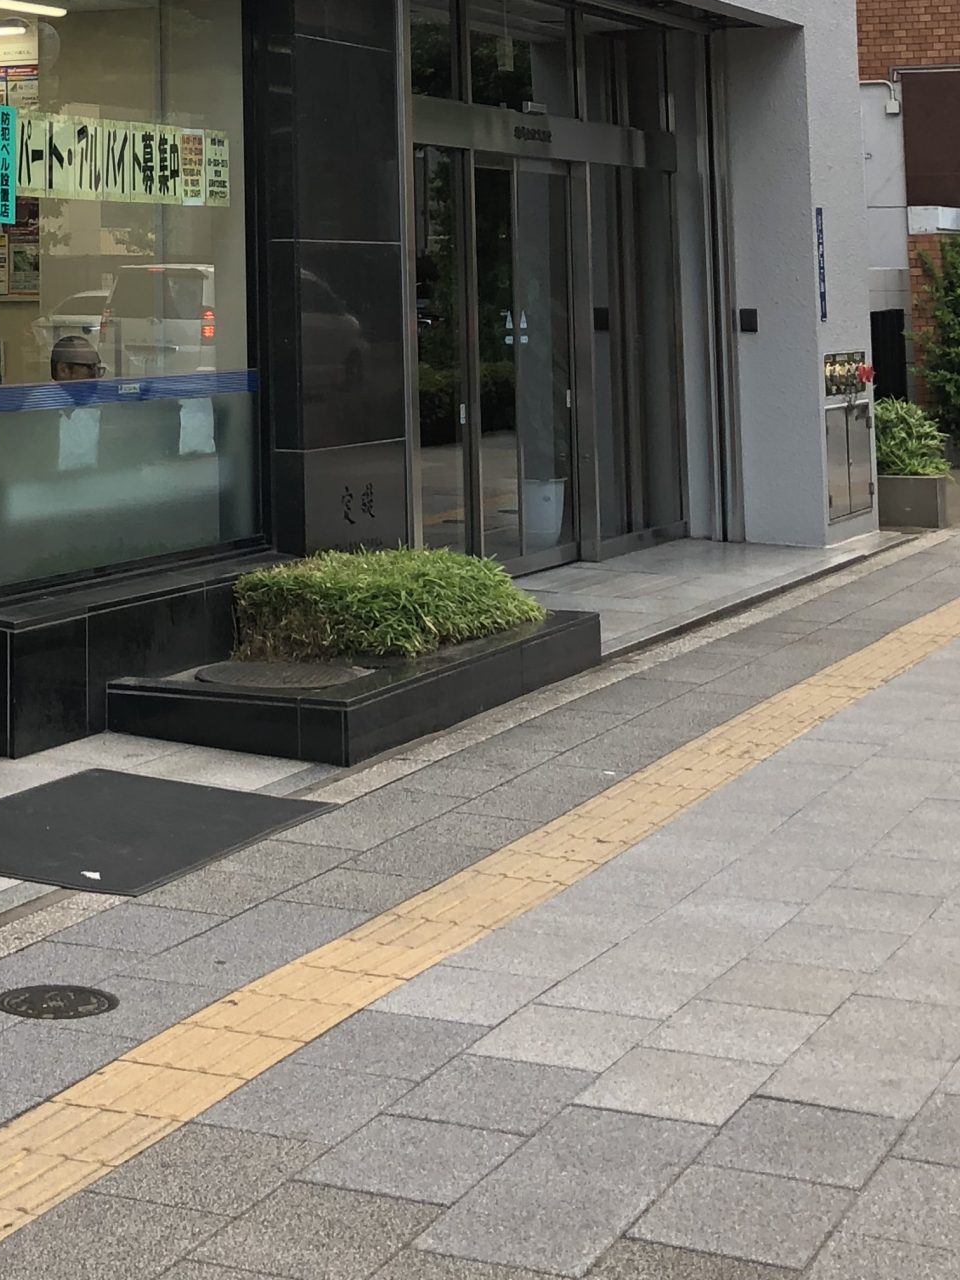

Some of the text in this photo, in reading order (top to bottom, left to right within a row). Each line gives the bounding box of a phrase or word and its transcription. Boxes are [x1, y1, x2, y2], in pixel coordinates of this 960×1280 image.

[0, 110, 11, 218] 防犯ベル設置店
